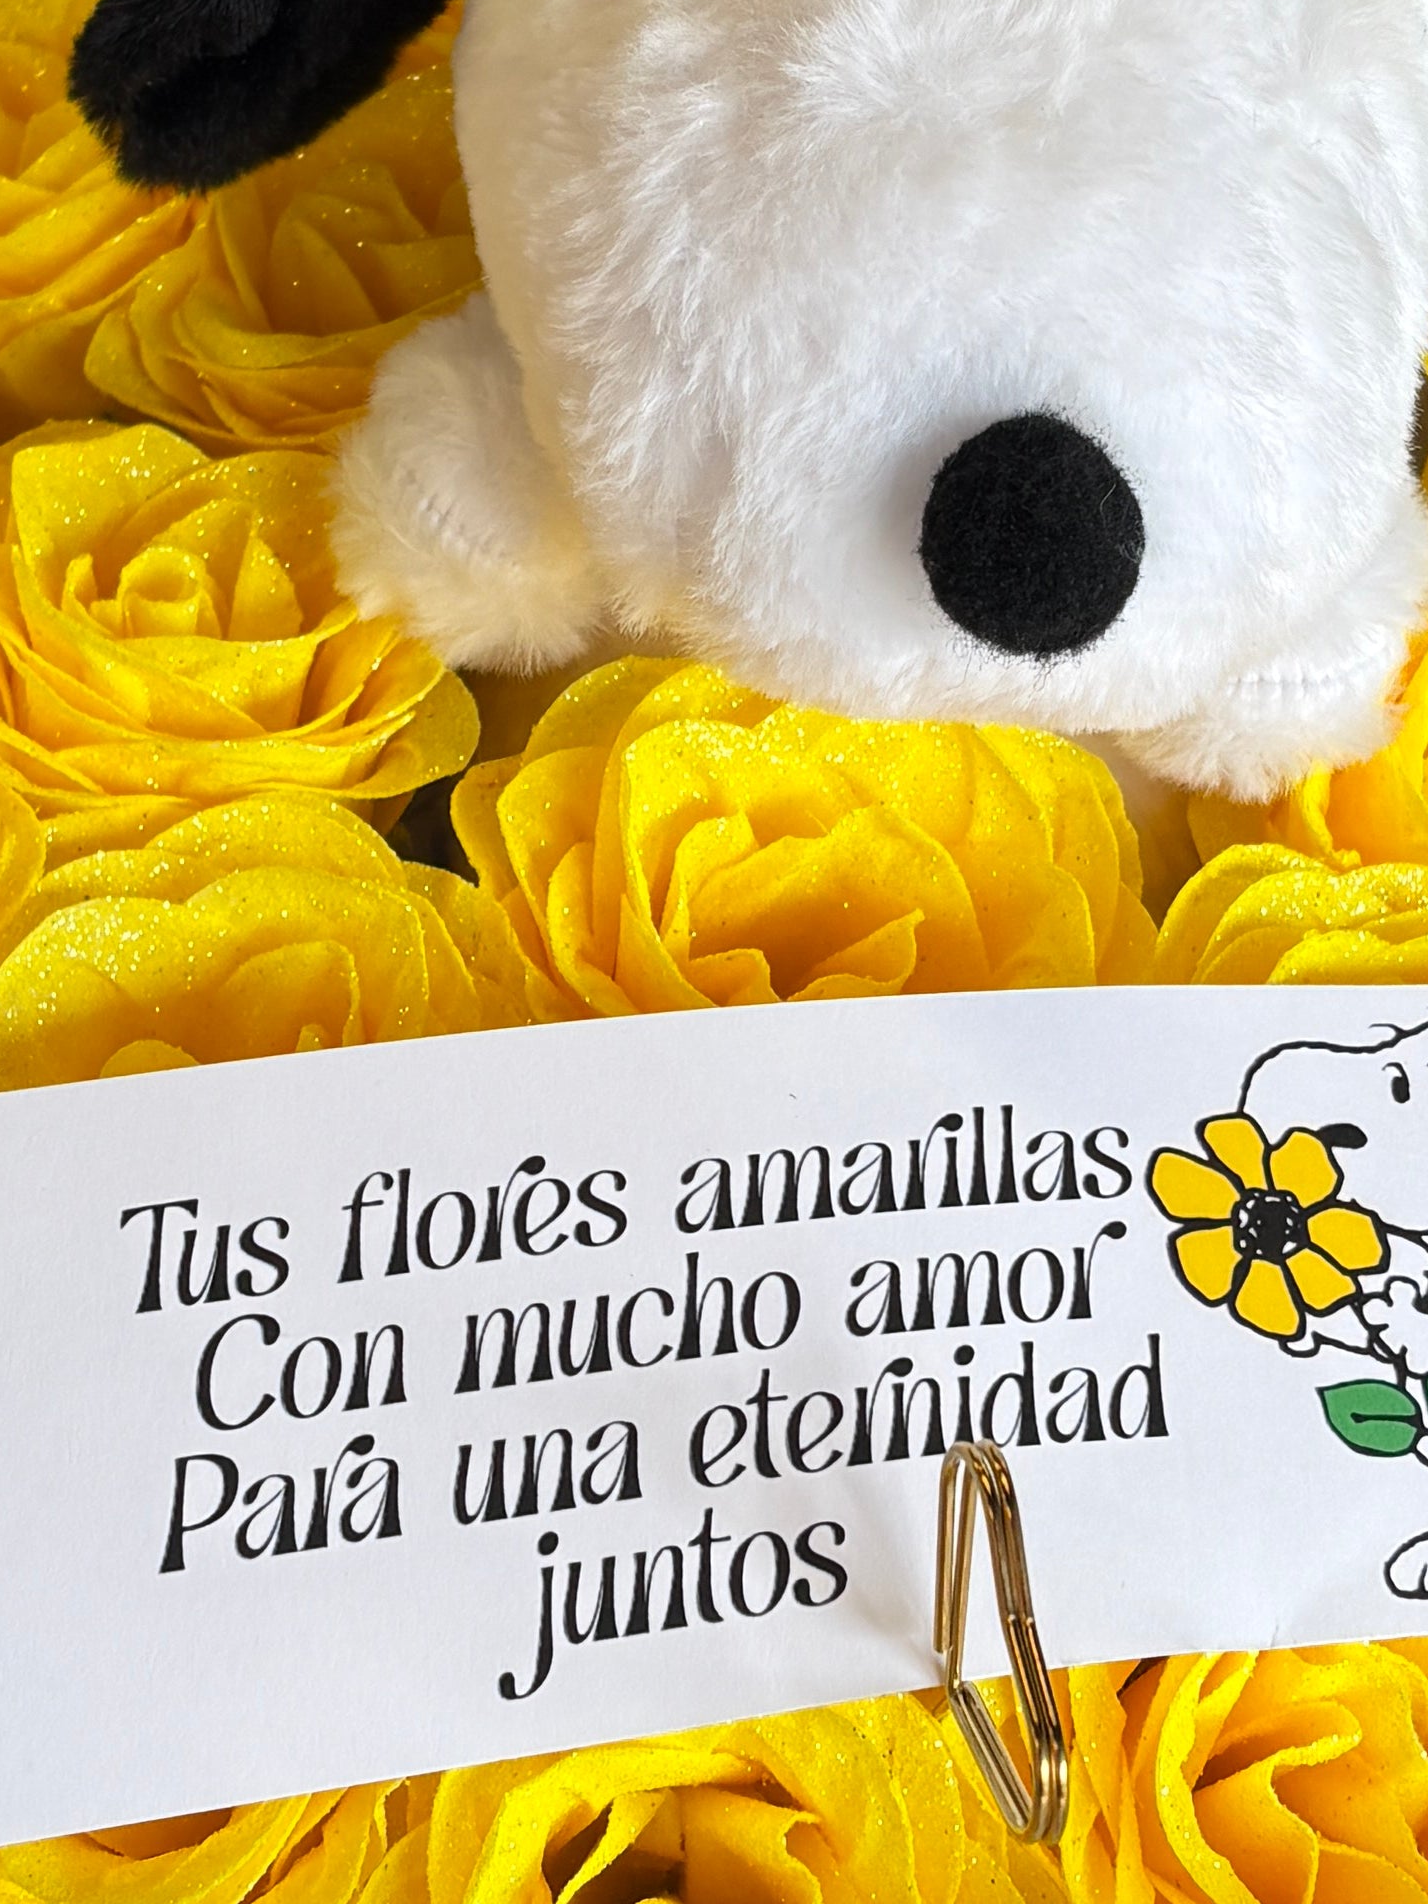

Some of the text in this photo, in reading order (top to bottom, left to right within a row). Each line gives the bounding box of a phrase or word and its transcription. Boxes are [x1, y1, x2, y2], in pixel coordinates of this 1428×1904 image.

[119, 1103, 1134, 1315] Tus flores amarillas
[195, 1220, 1128, 1432] Con mucho amor
[158, 1332, 1170, 1575] Para una eternidad
[497, 1506, 849, 1702] juntos
